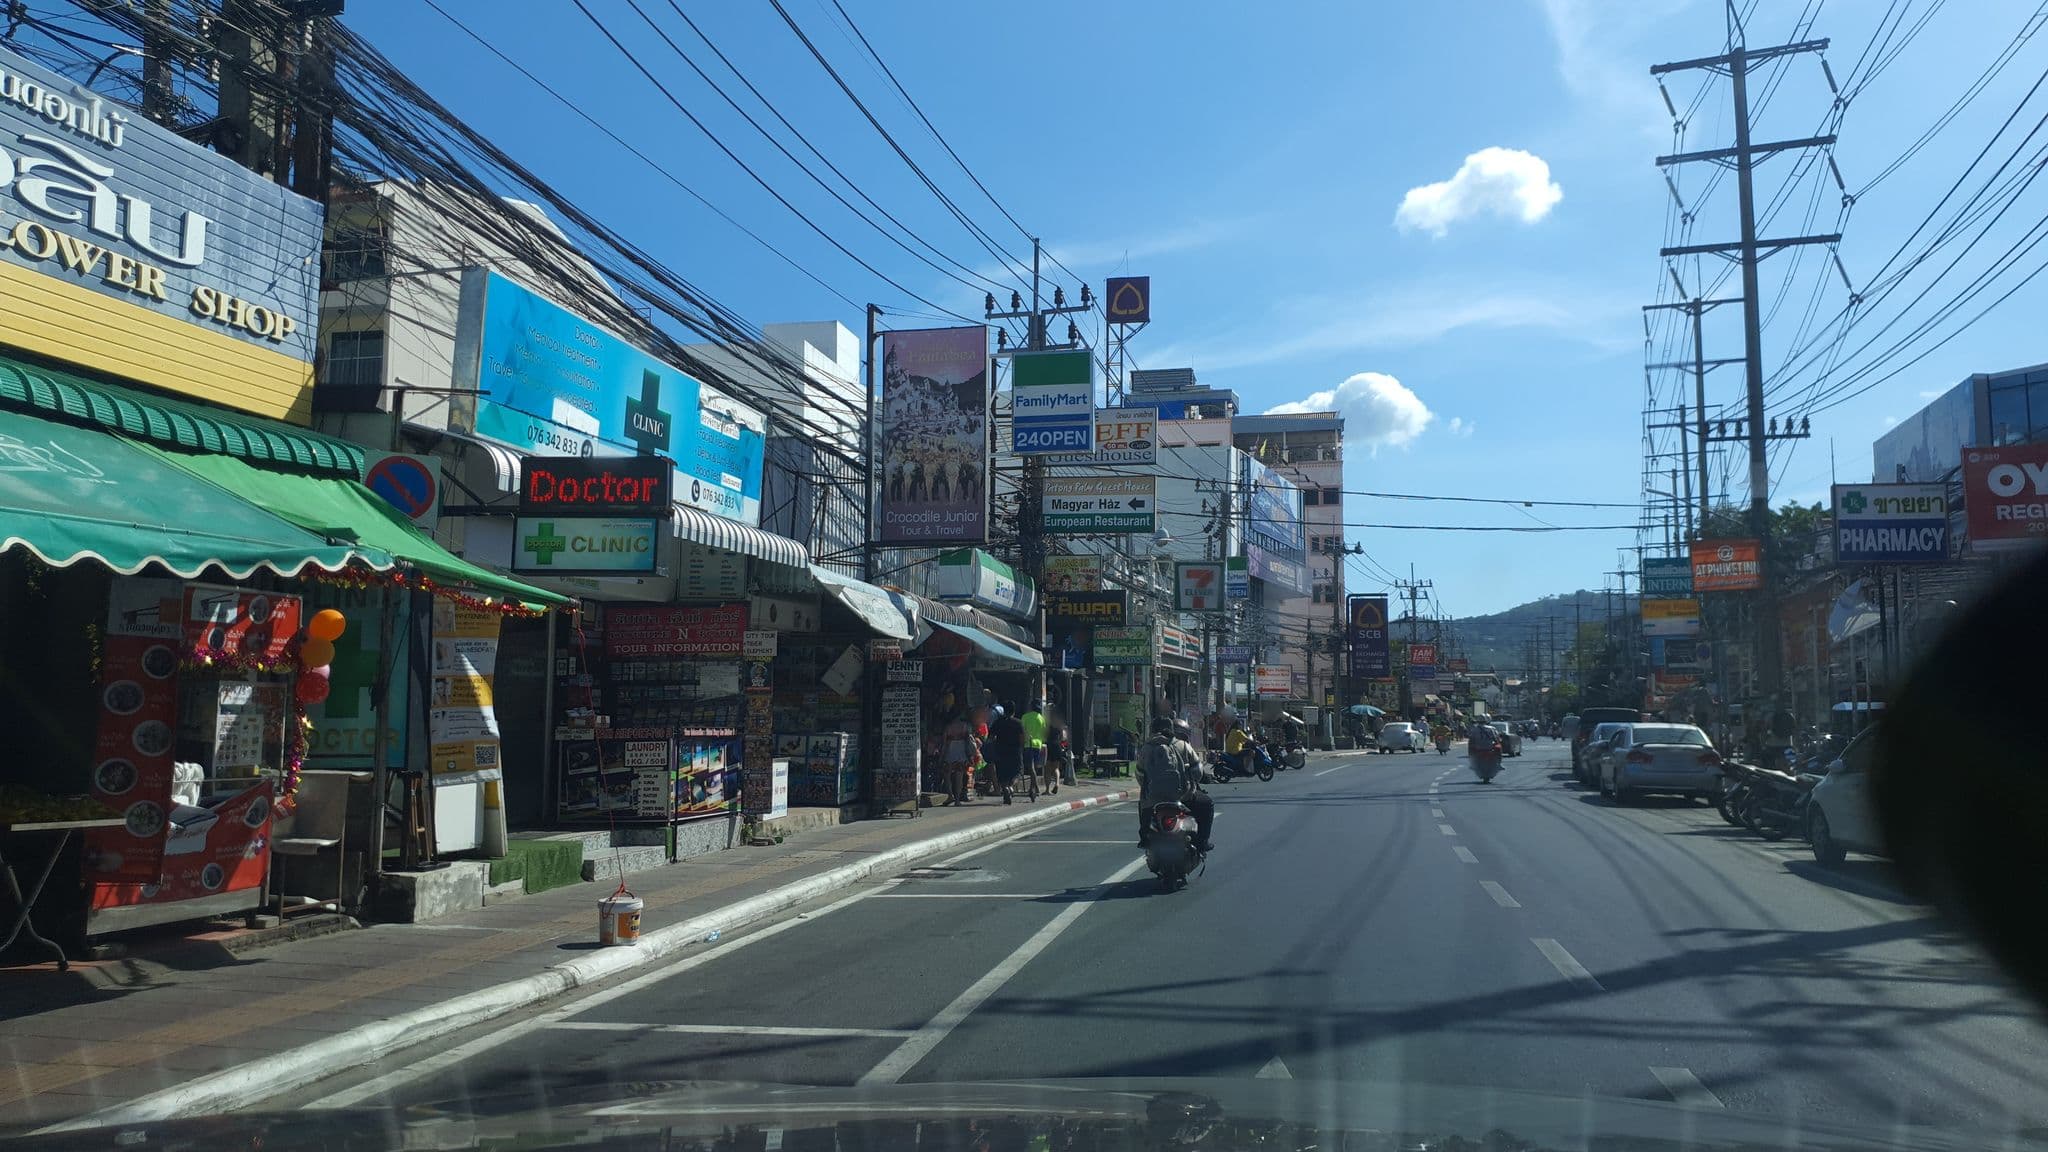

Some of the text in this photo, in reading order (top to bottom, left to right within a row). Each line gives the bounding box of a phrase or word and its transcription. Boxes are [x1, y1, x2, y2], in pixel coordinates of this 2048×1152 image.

[191, 285, 297, 342] SHOP
[528, 326, 560, 352] Medical
[1016, 393, 1088, 409] FamilyMart
[633, 412, 664, 438] CLINIC
[527, 425, 578, 456] 076 342 833
[529, 470, 659, 503] Doctor
[1045, 482, 1073, 493] Patong
[1095, 481, 1122, 494] Guest
[1124, 480, 1151, 491] House
[702, 487, 736, 510] 076 342 833
[1052, 498, 1121, 512] Magyar Ház
[1873, 496, 1944, 513] ขายยา
[886, 510, 979, 523] Crocodile Junior
[1044, 515, 1151, 529] European Restaurant
[901, 525, 964, 536] Tour & Travel
[570, 535, 649, 553] CLINIC
[1839, 527, 1945, 552] PHARMACY
[1707, 561, 1742, 576] PHUKET
[1359, 629, 1382, 639] SCB
[614, 642, 740, 653] TOUR INFORMATION
[887, 661, 922, 670] JENNY
[626, 742, 666, 751] LAUNDRY
